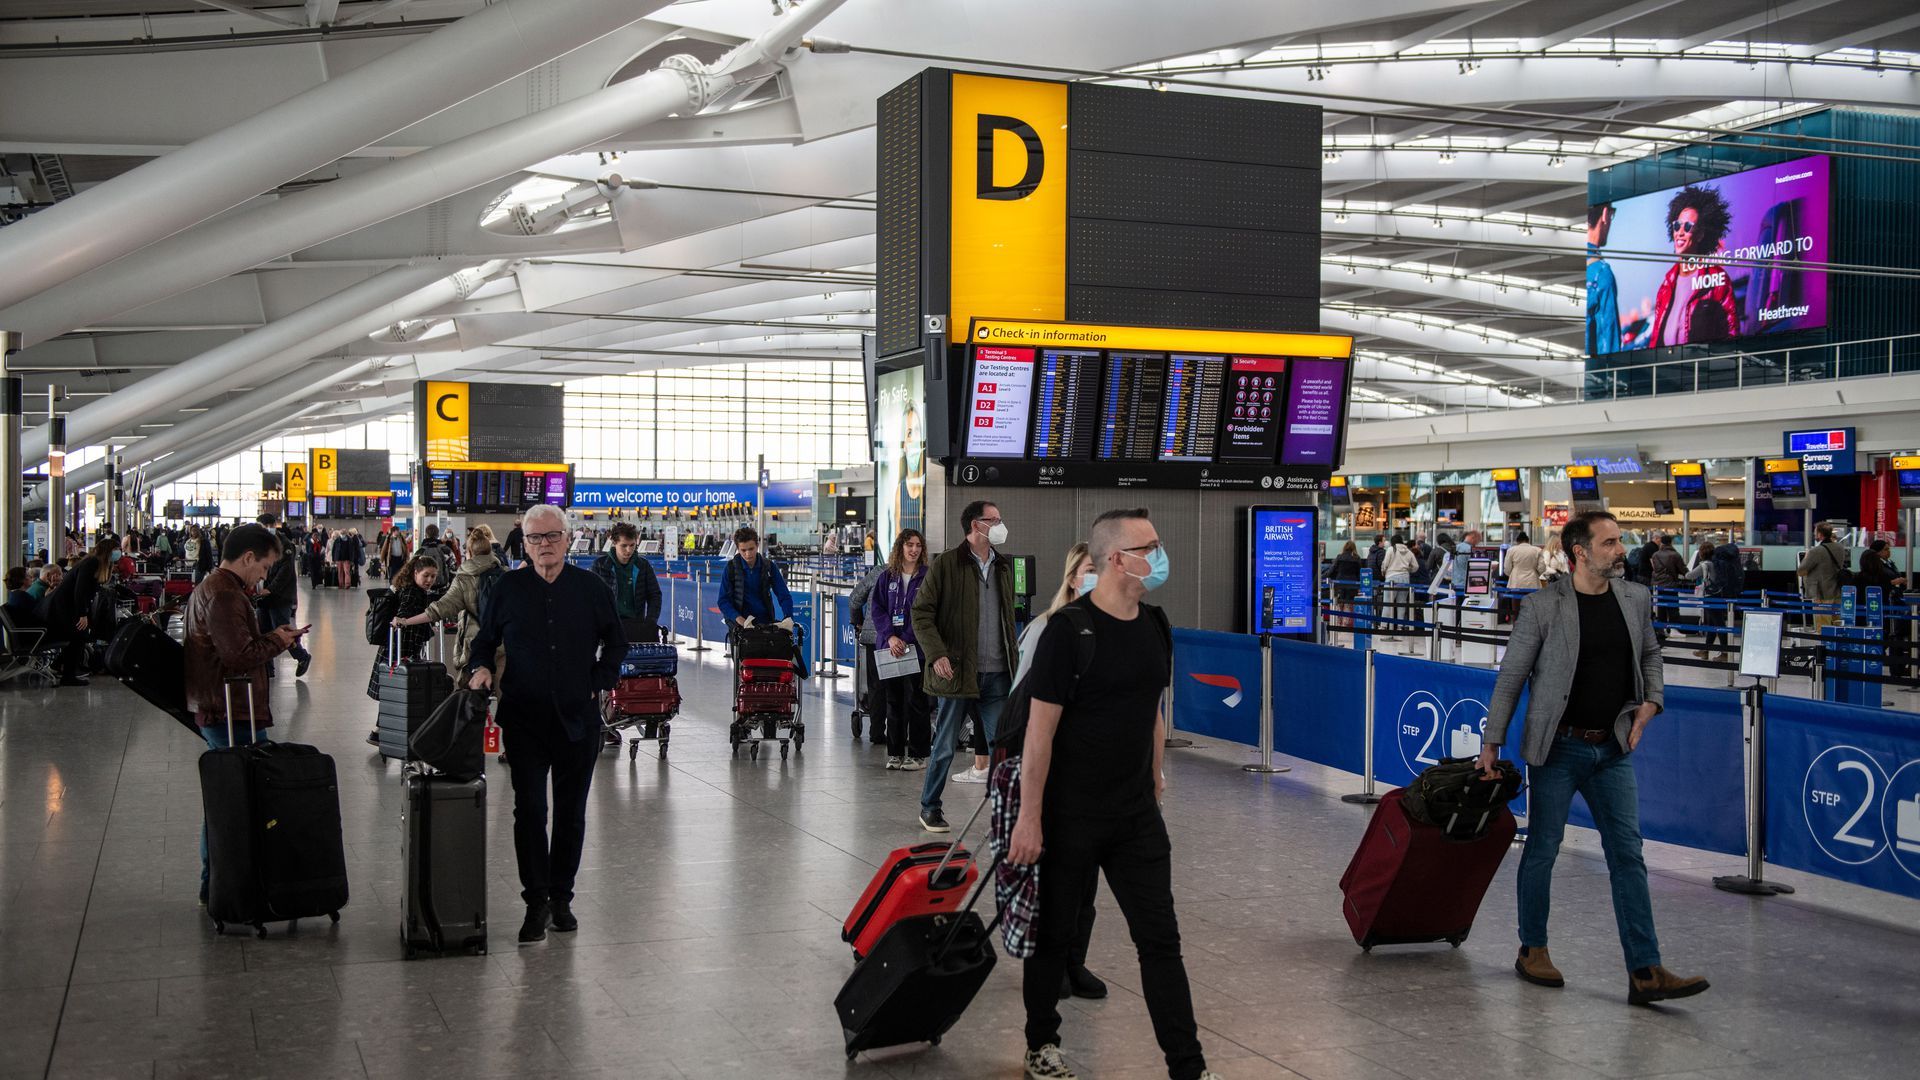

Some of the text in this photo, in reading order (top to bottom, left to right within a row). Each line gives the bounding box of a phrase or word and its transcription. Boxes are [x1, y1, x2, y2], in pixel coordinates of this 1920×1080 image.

[977, 113, 1044, 201] D
[1776, 171, 1813, 184] heathrow.com
[1734, 240, 1792, 262] FORWARD
[1795, 236, 1813, 252] TO
[1691, 272, 1726, 290] MORE
[1759, 305, 1809, 321] Heathrow
[992, 327, 1107, 342] Check-in information
[990, 364, 1009, 372] Testing
[880, 383, 907, 406] Fly Safe
[981, 384, 993, 392] A1
[436, 393, 459, 422] C
[980, 401, 991, 409] D2
[978, 418, 989, 426] D3
[319, 454, 331, 469] B
[1803, 454, 1832, 462] Currency
[290, 467, 304, 480] A
[1803, 463, 1833, 471] Exchange
[573, 489, 737, 503] arm welcome to our home.
[1265, 525, 1293, 533] BRITISH
[1263, 533, 1293, 541] AIRWAYS
[685, 606, 694, 622] Drop
[1402, 724, 1420, 736] STEP
[1415, 701, 1439, 765] 2
[488, 737, 496, 748] 5
[1811, 790, 1840, 807] STEP
[1832, 760, 1875, 848] 2
